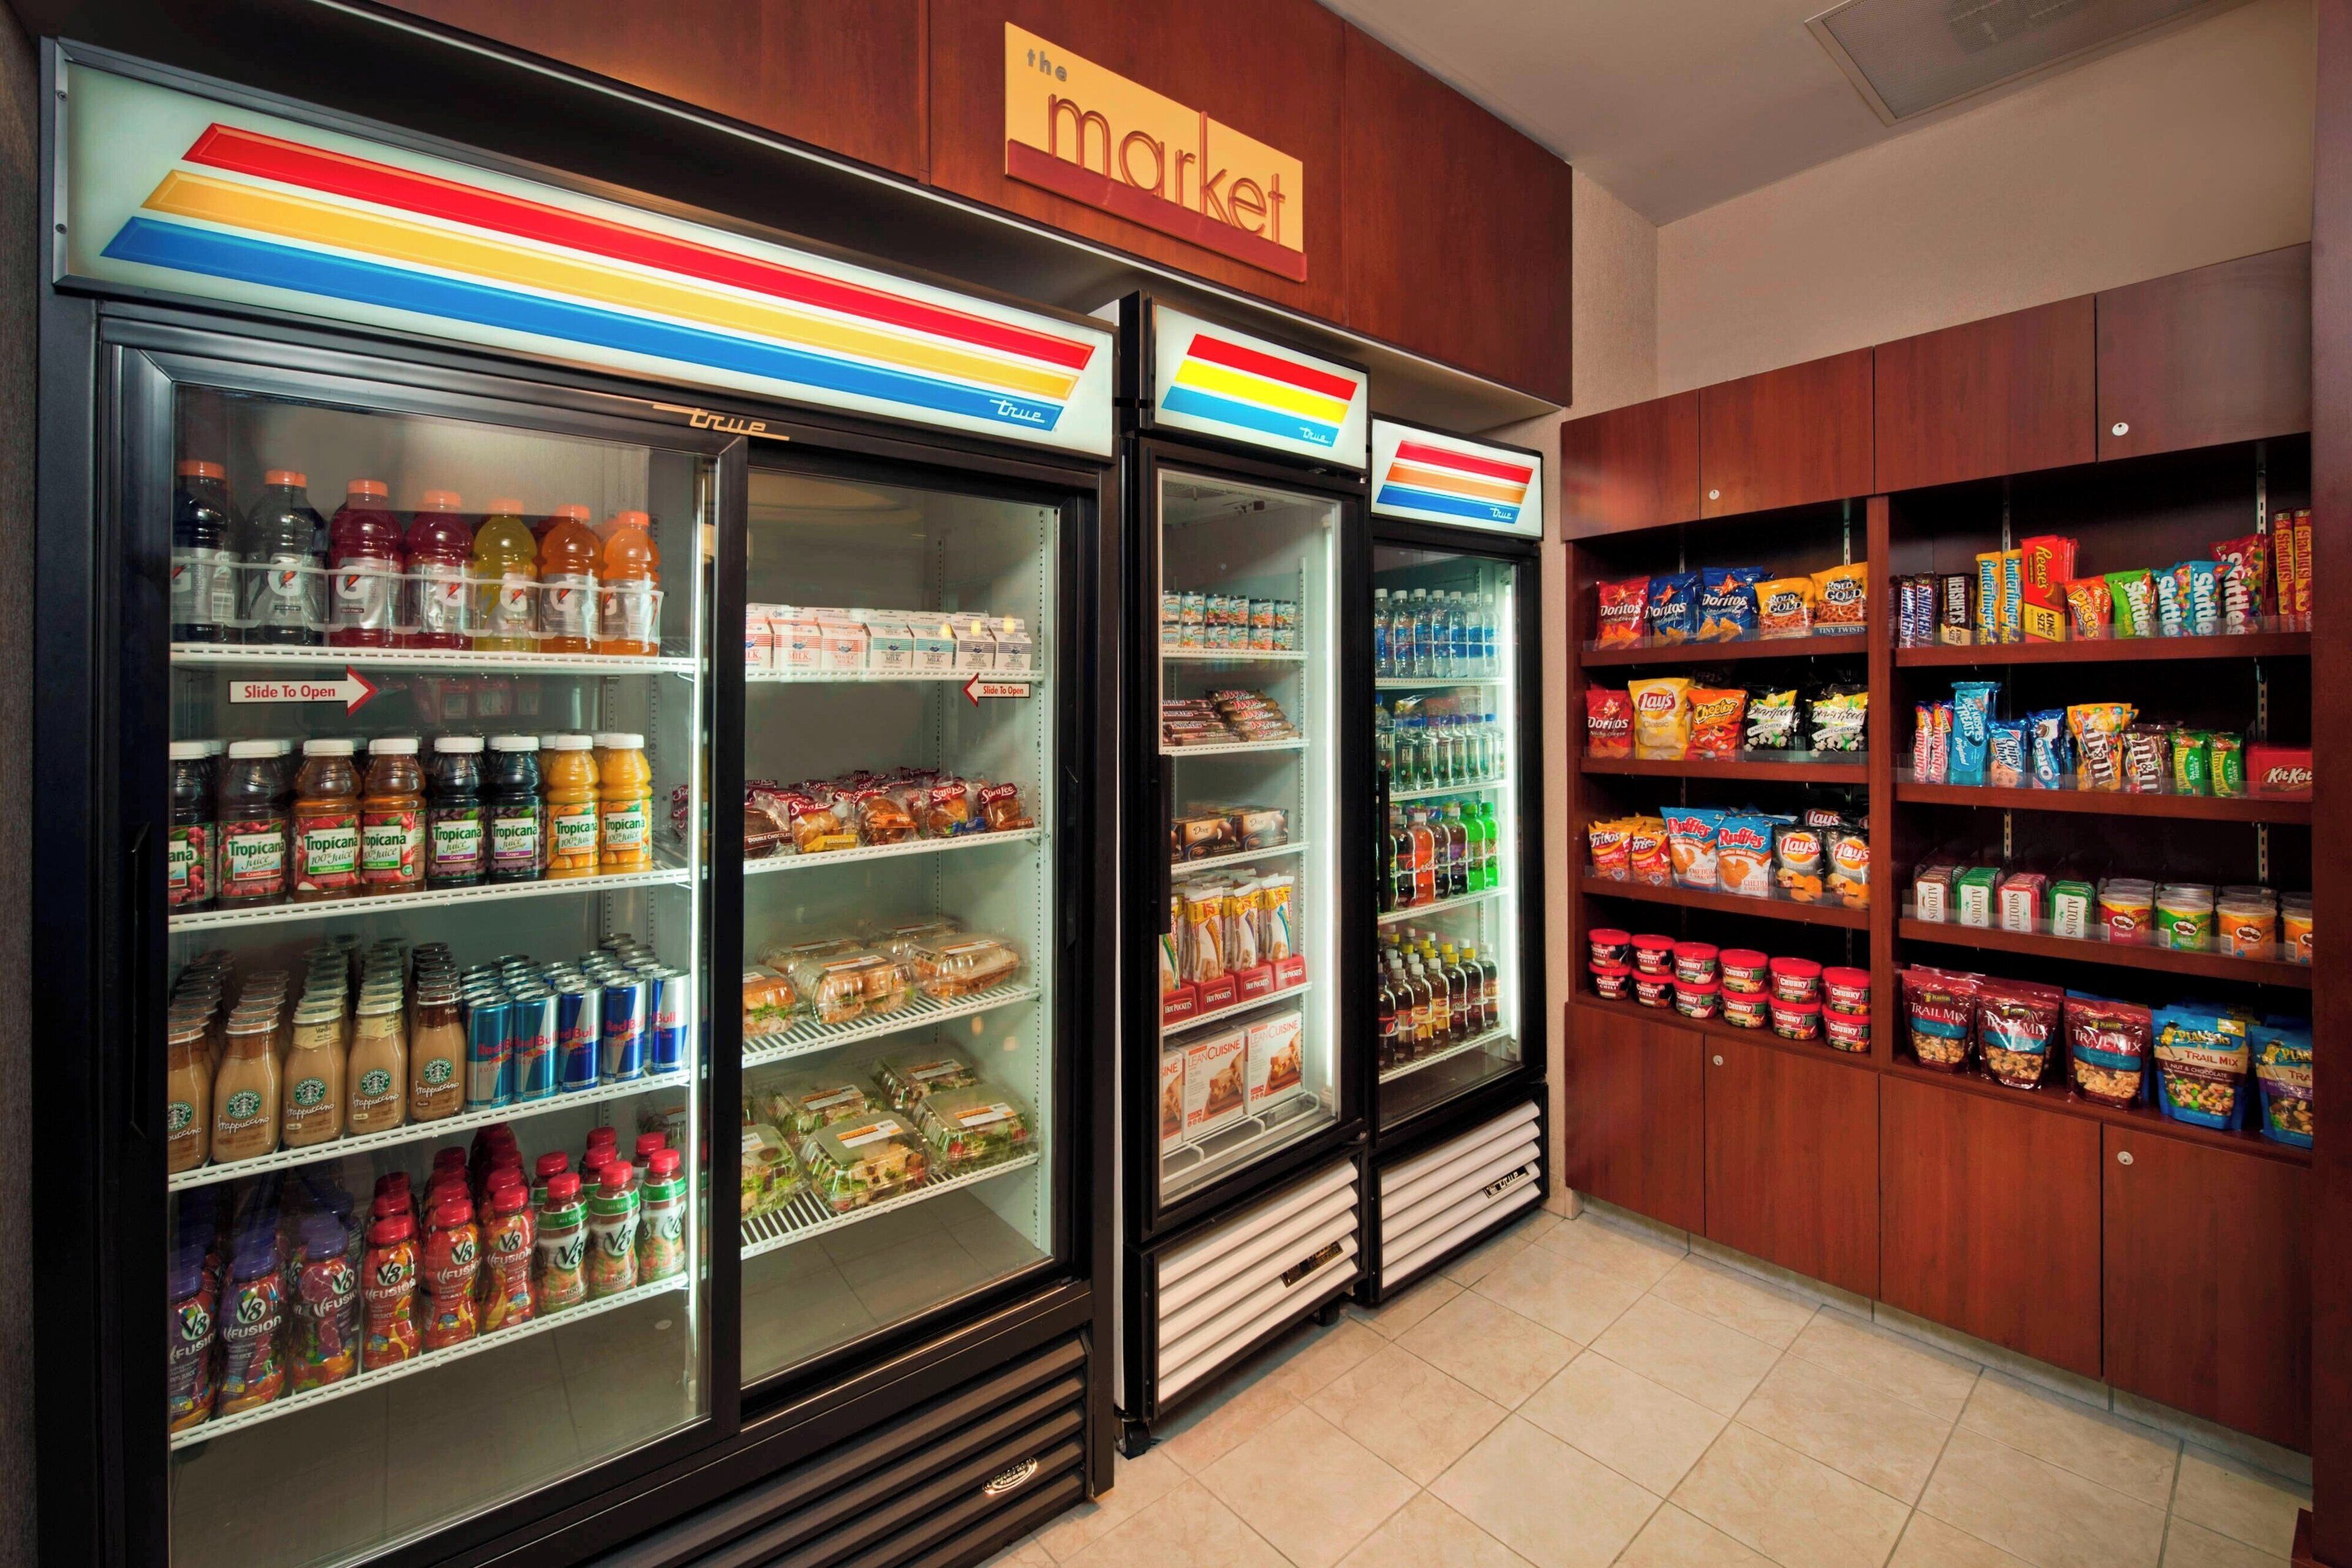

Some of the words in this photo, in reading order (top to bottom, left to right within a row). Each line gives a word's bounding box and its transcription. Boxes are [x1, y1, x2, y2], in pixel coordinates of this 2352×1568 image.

[1027, 48, 1067, 81] the
[1048, 94, 1285, 245] market
[1825, 589, 1862, 600] GOLD
[1826, 581, 1852, 591] ROLD
[1980, 559, 1997, 628] Butterfinger
[1600, 603, 1642, 616] Doritos
[1703, 594, 1747, 606] Doritos
[2124, 581, 2150, 637] Skittles
[1917, 586, 1932, 640] SNICKERS
[2037, 613, 2045, 633] SIZE
[2046, 612, 2055, 638] KING
[245, 685, 277, 698] Slide
[282, 685, 296, 697] To
[301, 685, 336, 699] Open
[1640, 692, 1673, 711] Lay's
[1588, 716, 1629, 729] Doritos
[1954, 704, 1974, 737] TREATS
[2005, 739, 2019, 766] Chips
[434, 826, 481, 842] Tropicana
[492, 824, 537, 839] Tropicana
[604, 818, 645, 832] Tropicana
[1667, 817, 1713, 838] Ruffles
[228, 840, 285, 858] Tropicana
[305, 835, 358, 852] Tropicana
[1718, 827, 1766, 850] Ruffles
[1928, 885, 1938, 920] ALTOIDS
[1972, 889, 1982, 924] ALTOIDS
[2010, 892, 2020, 929] ALTOIDS
[2066, 898, 2079, 936] ALTOIDS
[1910, 1002, 1941, 1017] TRAIL
[1943, 1008, 1967, 1023] MIX
[1269, 1020, 1298, 1040] CUISINE
[1208, 1039, 1240, 1060] CUISINE
[2185, 1050, 2217, 1063] TRAIL
[2219, 1057, 2239, 1066] MIX
[2191, 1068, 2228, 1078] CHOCOLATE
[500, 1230, 521, 1251] V8
[559, 1236, 583, 1265] V8
[451, 1240, 474, 1264] V8
[377, 1262, 401, 1284] V8
[236, 1296, 263, 1322] V8
[231, 1316, 282, 1339] FUSION
